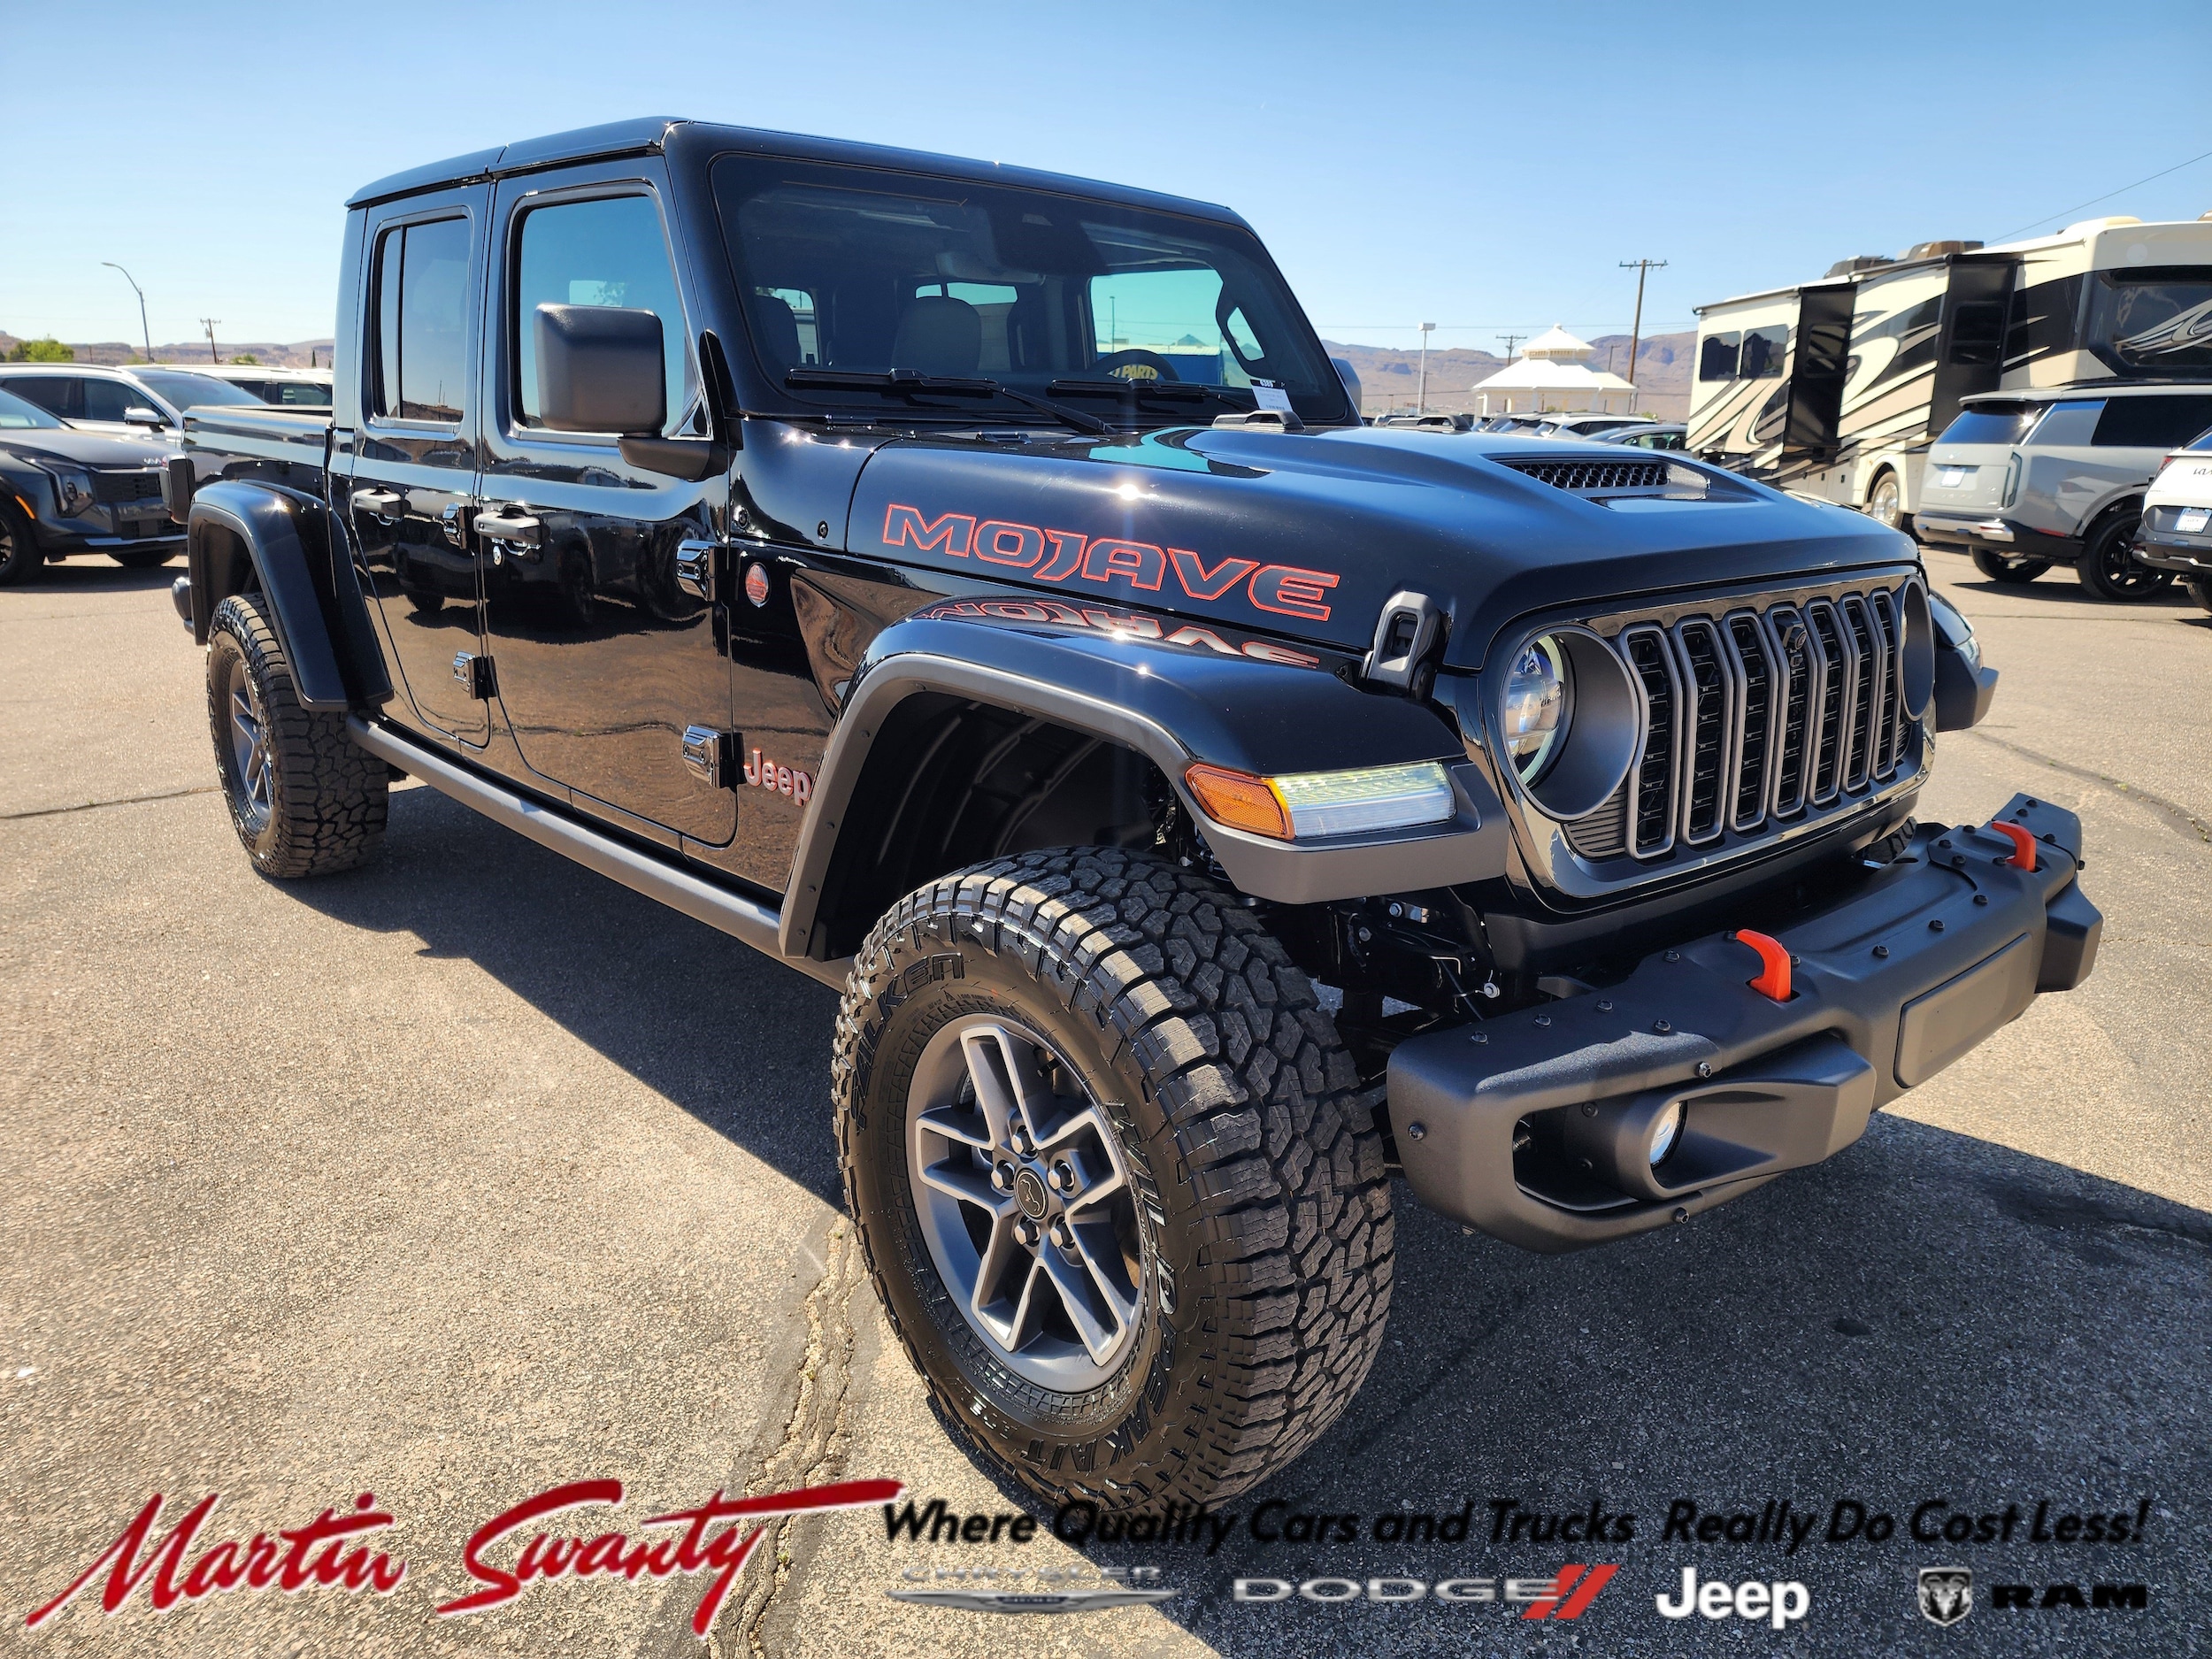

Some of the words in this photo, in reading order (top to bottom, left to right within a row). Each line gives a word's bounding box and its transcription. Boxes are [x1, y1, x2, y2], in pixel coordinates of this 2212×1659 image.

[883, 503, 1340, 622] MOJAVE
[743, 748, 812, 806] Jeep
[850, 951, 965, 1134] FALKEN
